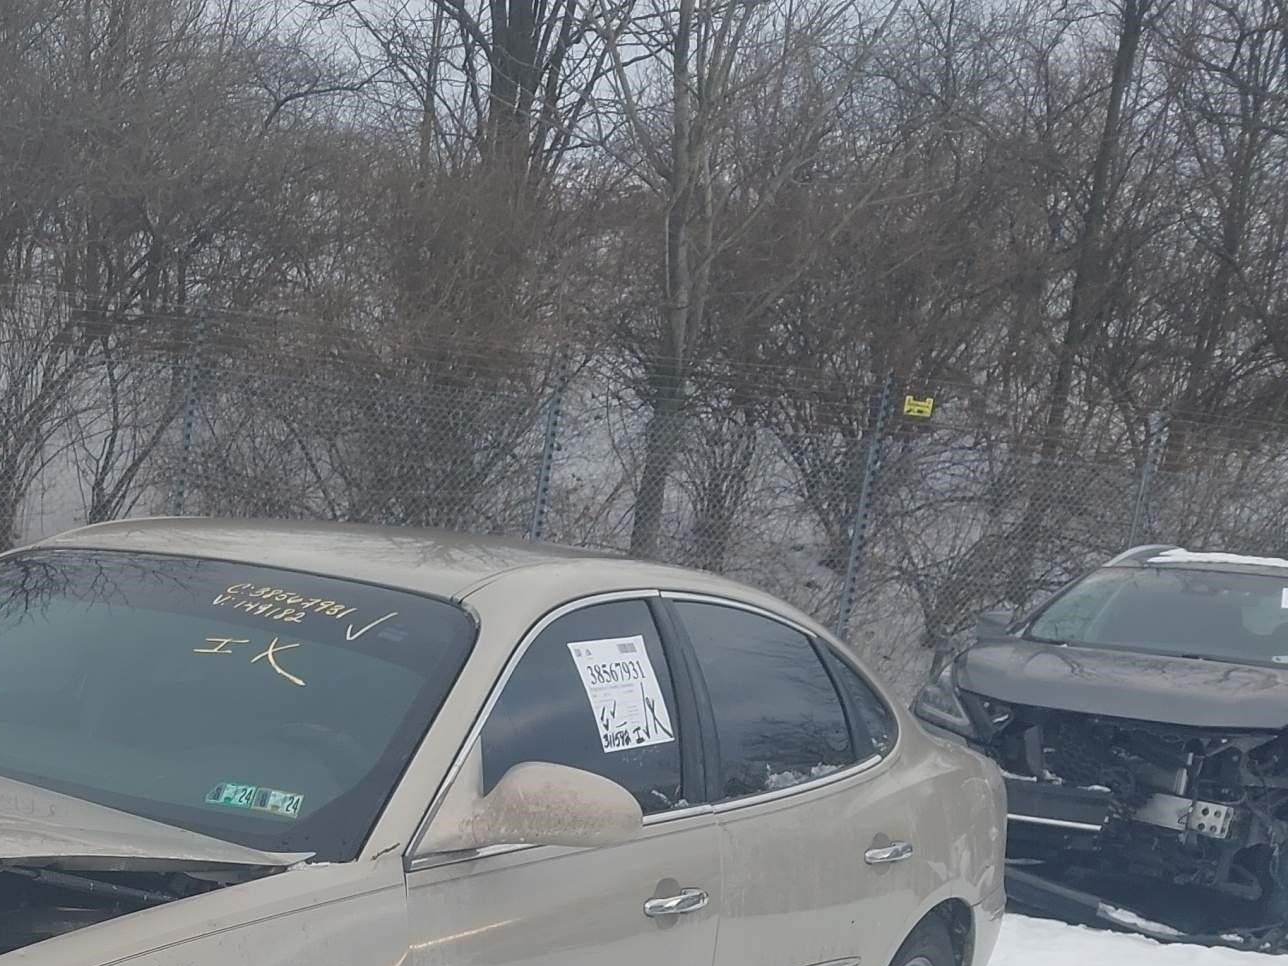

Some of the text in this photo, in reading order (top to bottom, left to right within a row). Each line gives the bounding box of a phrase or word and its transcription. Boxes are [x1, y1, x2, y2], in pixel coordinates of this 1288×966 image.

[586, 660, 647, 685] 38567931
[238, 787, 254, 804] 24
[285, 795, 301, 814] 24
